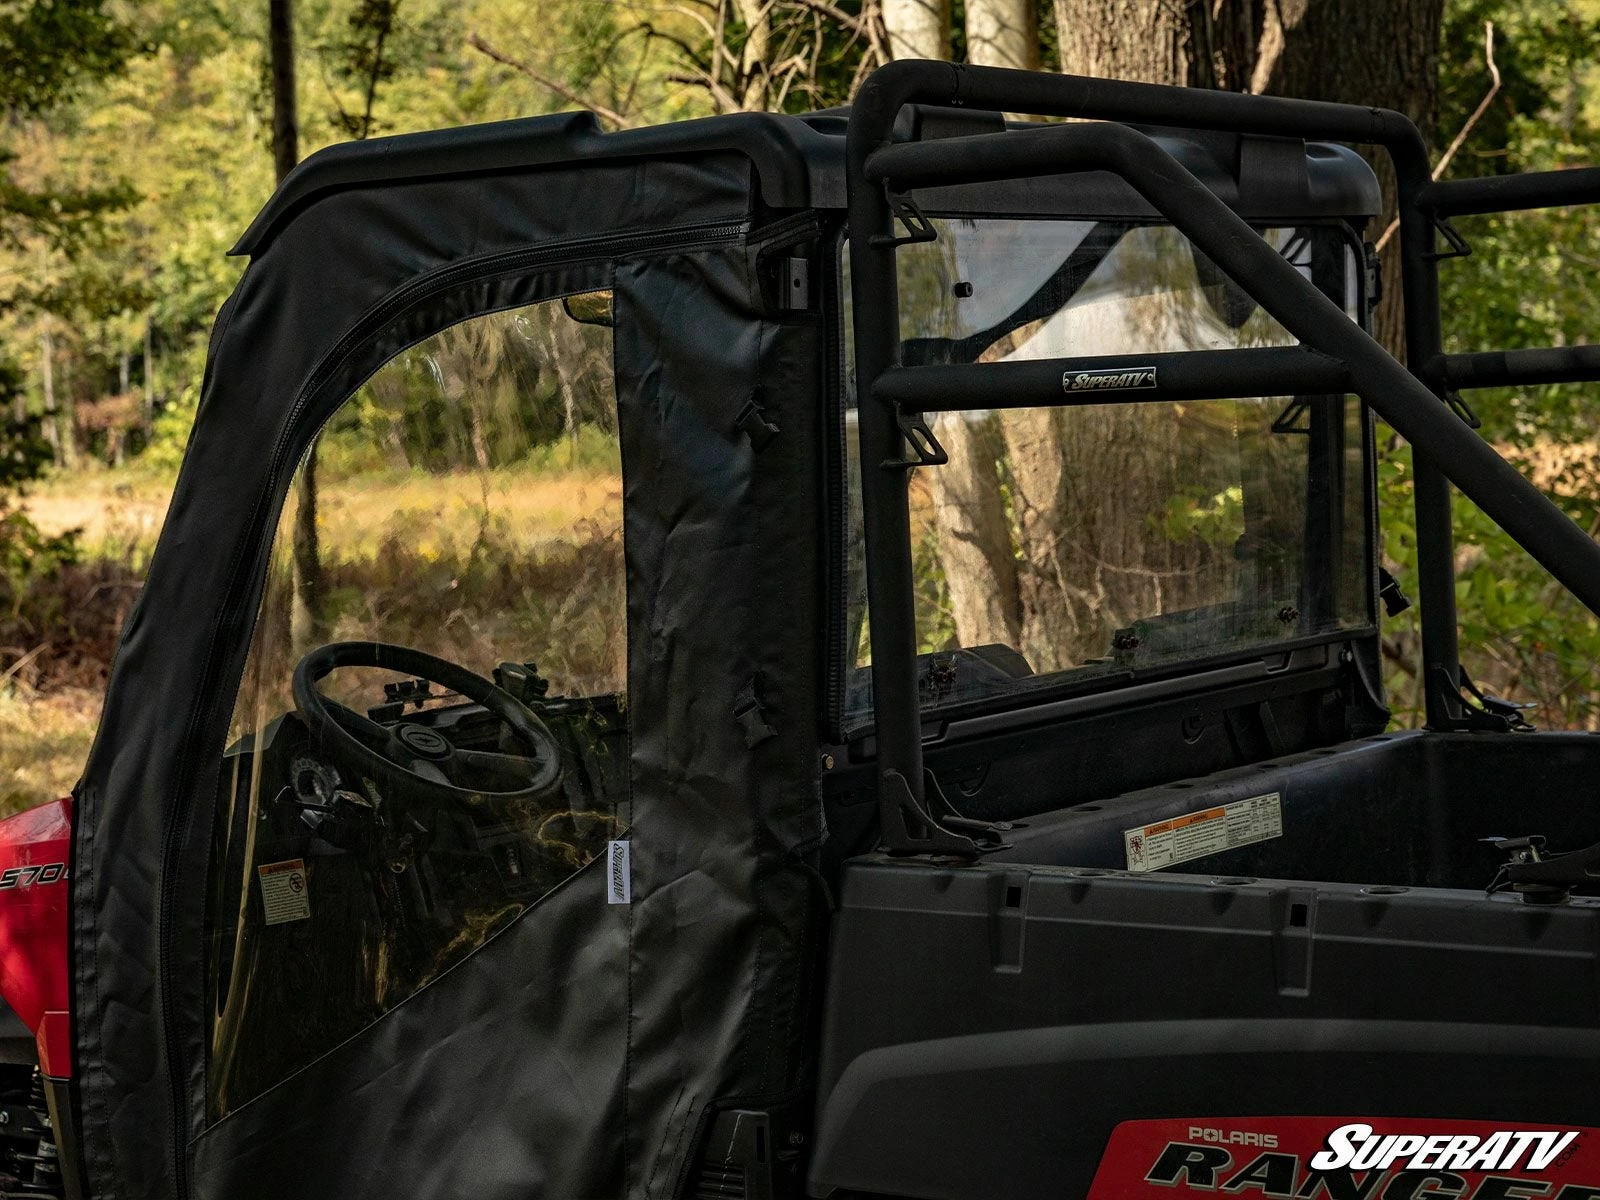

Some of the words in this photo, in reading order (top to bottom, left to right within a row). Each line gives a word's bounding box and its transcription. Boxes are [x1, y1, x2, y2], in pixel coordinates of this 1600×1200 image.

[0, 862, 64, 889] 570
[1188, 1126, 1279, 1148] POLARIS
[1144, 1141, 1600, 1200] RANGE
